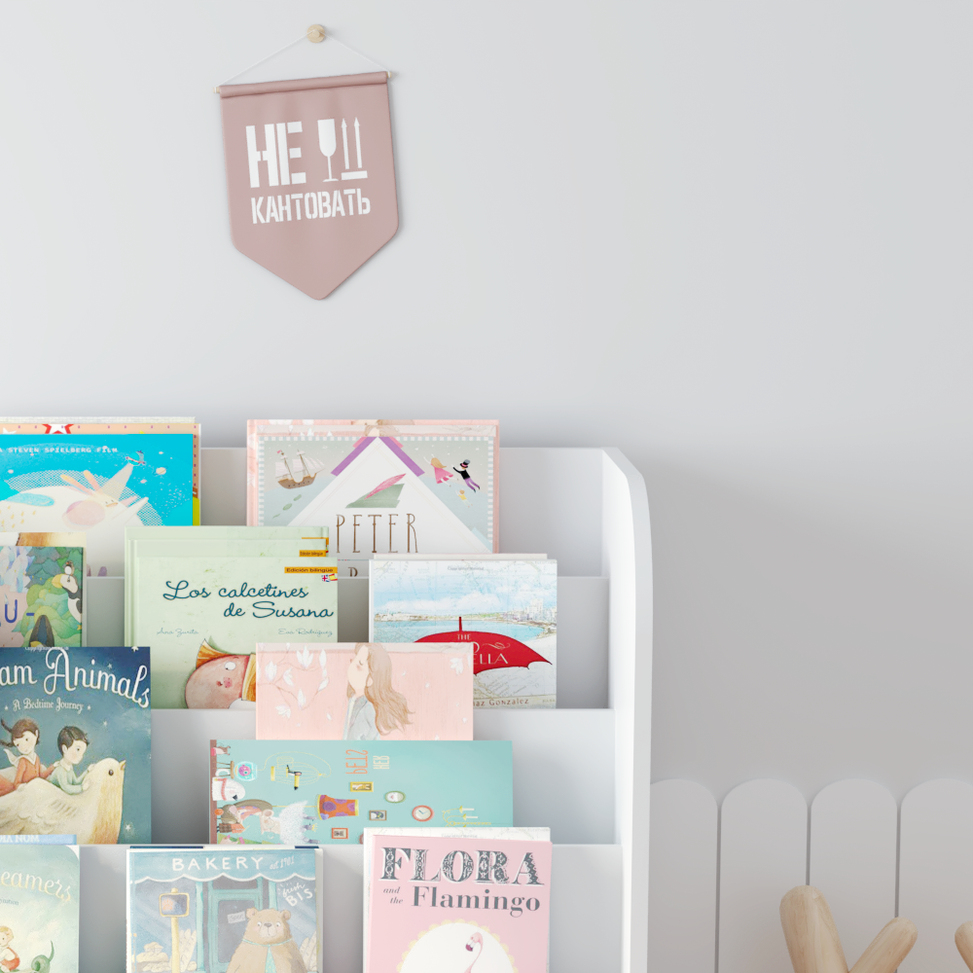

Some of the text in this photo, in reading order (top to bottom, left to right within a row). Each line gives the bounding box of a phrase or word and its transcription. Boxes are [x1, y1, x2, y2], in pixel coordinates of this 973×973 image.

[245, 121, 307, 189] НЕ
[250, 188, 371, 225] КАНТОВАТЬ
[336, 513, 419, 553] PETER
[162, 580, 309, 600] Los calcetines
[223, 600, 334, 618] de Susana
[43, 647, 150, 708] Animals
[12, 697, 84, 715] A Bedtime Journey
[172, 856, 264, 871] BAKERY
[379, 846, 545, 887] FLORA
[383, 886, 401, 894] and
[389, 897, 404, 905] the
[411, 886, 541, 918] Flamingo
